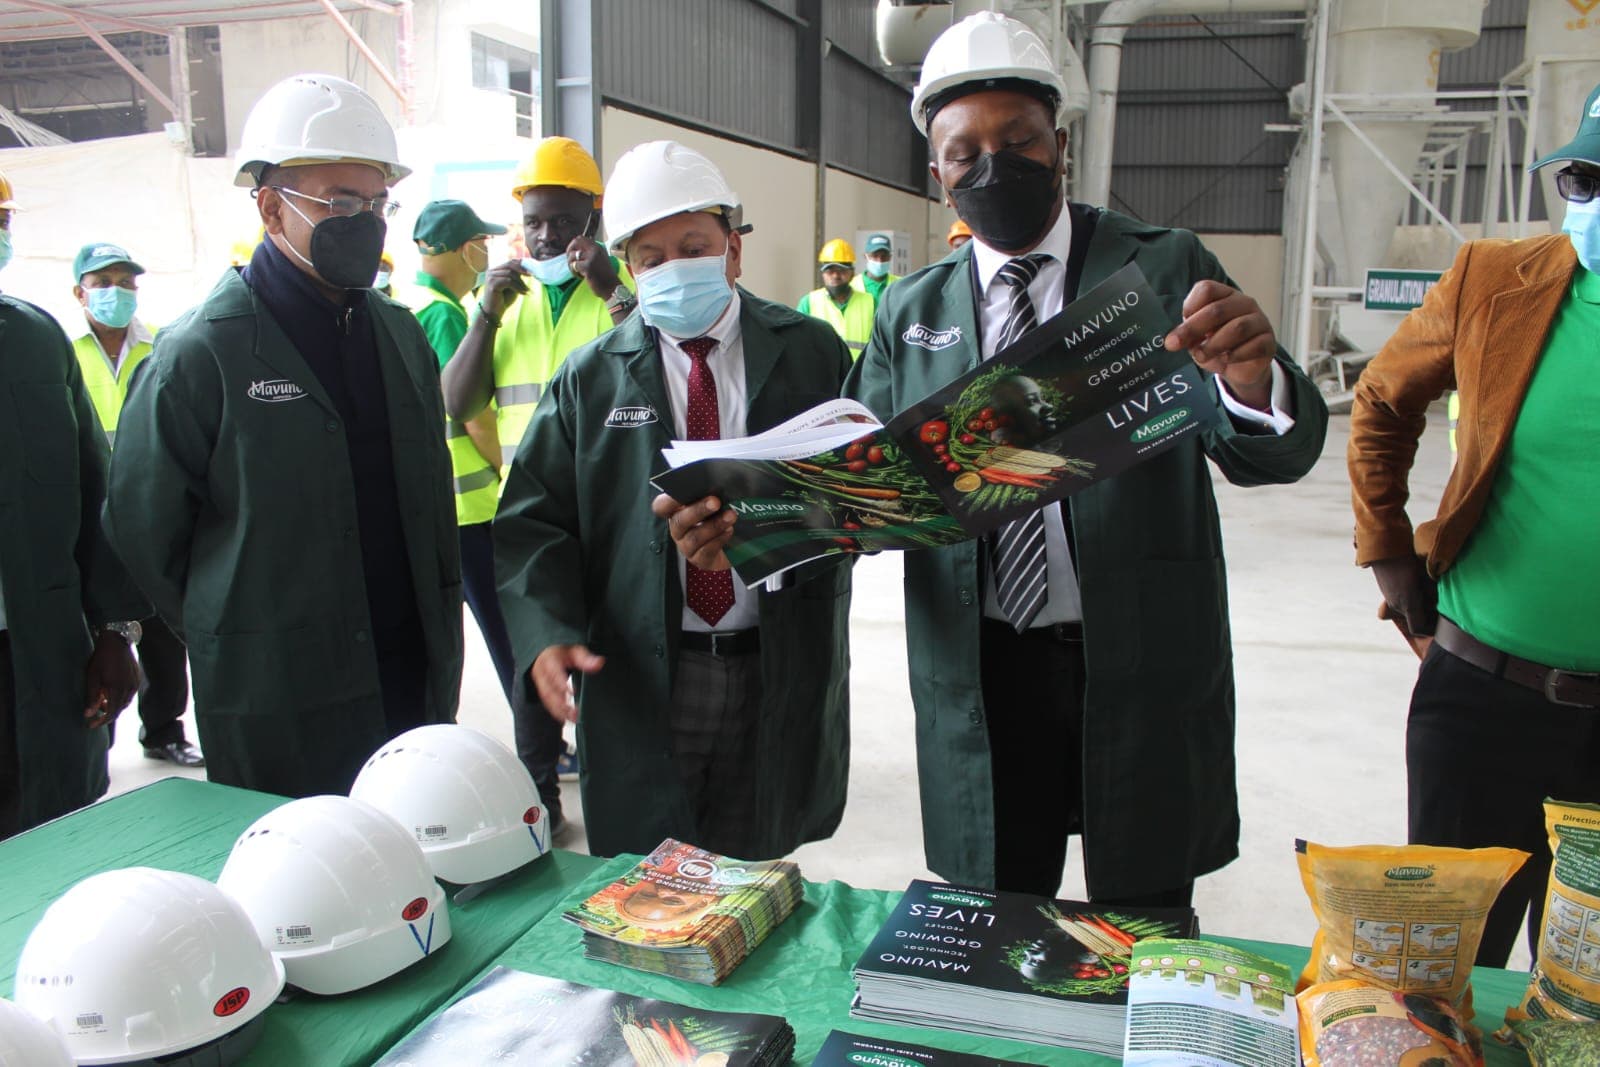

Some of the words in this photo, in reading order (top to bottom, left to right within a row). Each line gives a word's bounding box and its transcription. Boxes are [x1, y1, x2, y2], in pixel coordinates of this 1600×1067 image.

[1368, 279, 1424, 304] GRANULATION
[1064, 291, 1139, 349] MAVUNO
[1088, 335, 1165, 386] GROWING
[1136, 410, 1187, 439] Mavuno
[728, 500, 804, 517] Mavuno
[932, 894, 985, 907] Mavuno
[1357, 921, 1365, 929] 1
[1412, 925, 1425, 934] 2
[895, 930, 982, 949] GROWING
[880, 953, 971, 973] MAVUNO
[1355, 955, 1366, 963] 3
[1409, 960, 1420, 969] 4
[221, 991, 245, 1012] JSP
